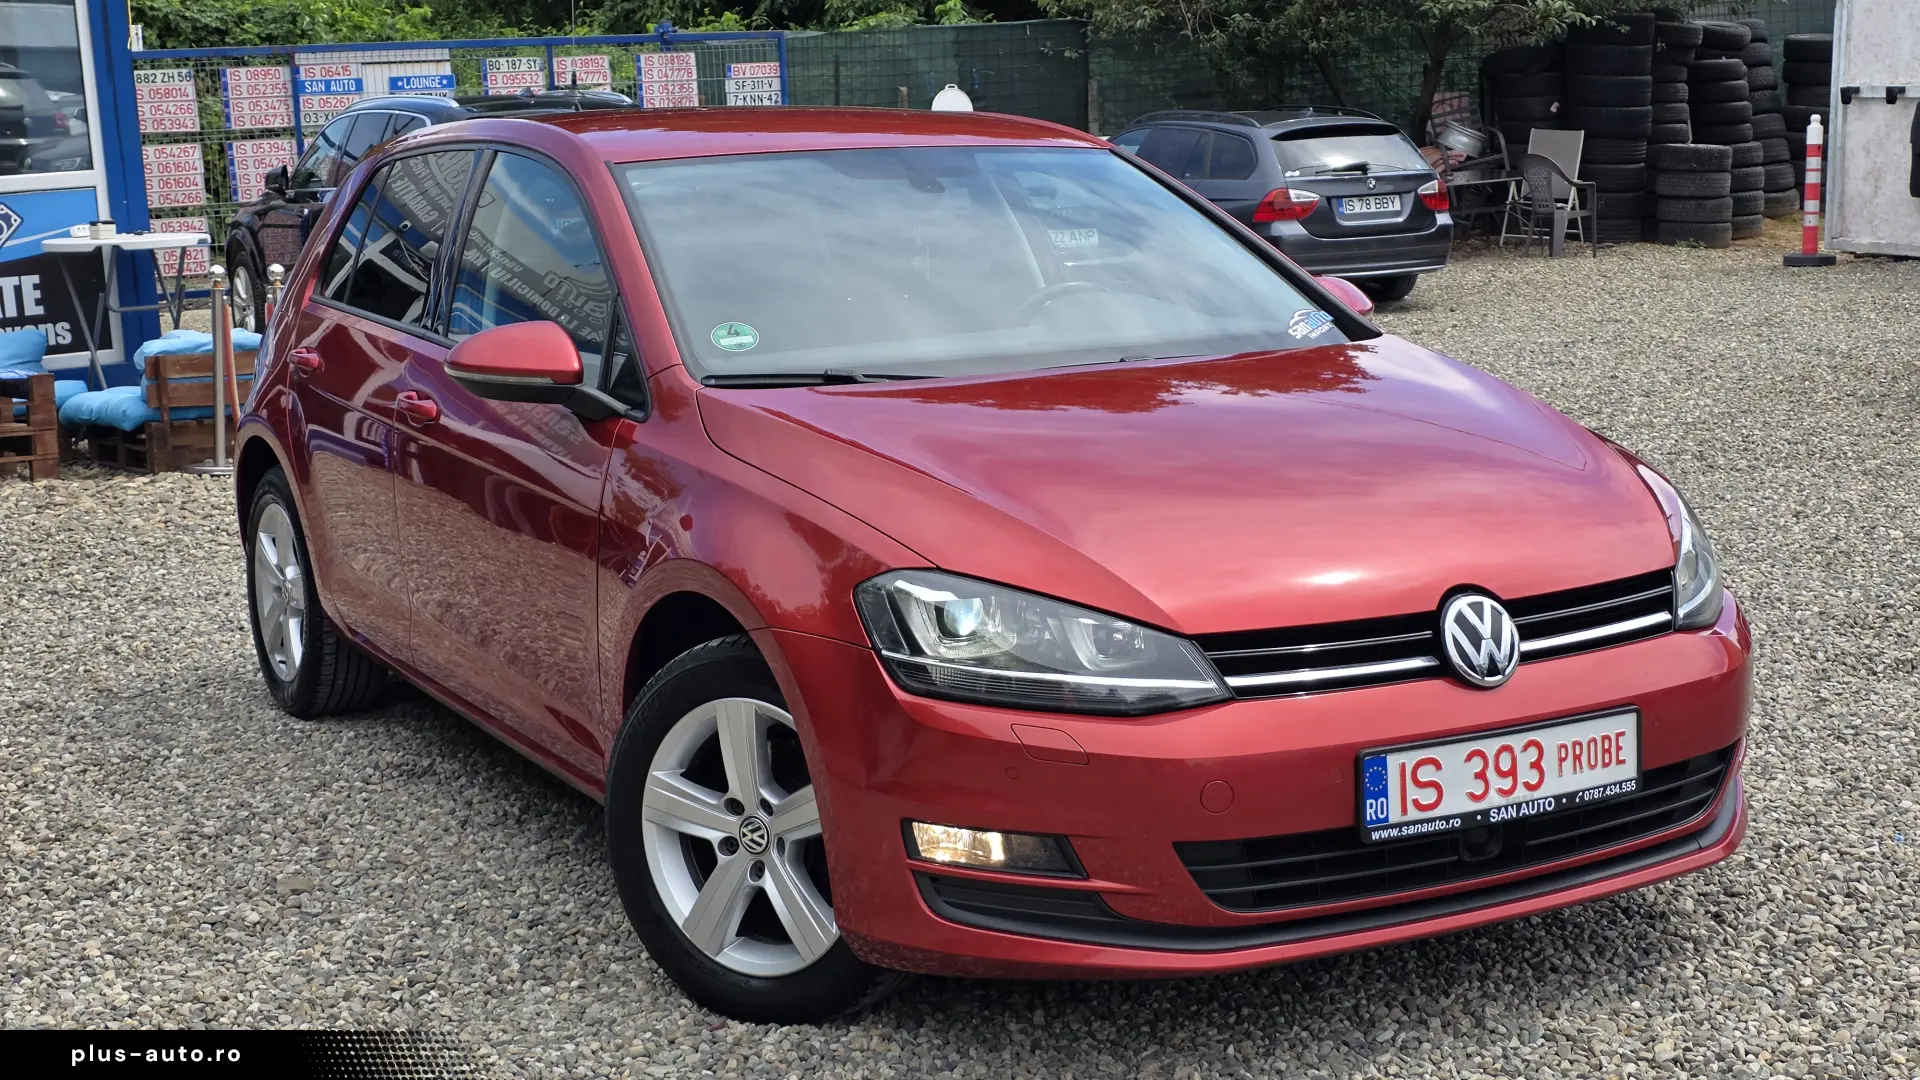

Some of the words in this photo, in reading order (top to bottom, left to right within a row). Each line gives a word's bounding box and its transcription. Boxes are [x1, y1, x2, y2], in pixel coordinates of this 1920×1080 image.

[556, 59, 567, 70] IS
[645, 56, 654, 66] IS
[229, 70, 241, 81] IS
[246, 69, 280, 81] 08950
[304, 67, 316, 78] IS
[320, 65, 352, 78] 06415
[556, 72, 567, 83] IS
[571, 71, 608, 82] 47778
[644, 69, 654, 79] IS
[732, 66, 747, 76] BV
[749, 65, 780, 76] 07039
[136, 73, 158, 84] 882
[160, 72, 175, 83] ZH
[404, 76, 442, 89] LOUNGE
[489, 75, 498, 85] B
[502, 73, 540, 85] 095532
[231, 84, 243, 96] IS
[247, 83, 289, 95] 052355
[305, 81, 325, 93] SAN
[330, 80, 356, 92] AUTO
[645, 85, 654, 95] IS
[136, 88, 144, 100] S
[149, 87, 189, 99] 058014
[137, 105, 145, 117] S
[150, 103, 193, 116] 054266
[232, 101, 244, 112] IS
[248, 99, 290, 111] 053475
[302, 98, 314, 109] IS
[139, 119, 147, 131] S
[152, 118, 196, 131] 053943
[234, 116, 246, 127] IS
[250, 114, 292, 126] 045733
[142, 148, 149, 160] S
[154, 146, 197, 159] 054267
[235, 143, 247, 155] IS
[252, 141, 293, 154] 053943
[144, 163, 153, 174] S
[157, 161, 198, 174] 061604
[237, 159, 249, 170] IS
[146, 179, 154, 190] S
[158, 176, 198, 190] 061604
[239, 173, 251, 185] IS
[147, 195, 154, 206] S
[158, 192, 202, 205] 054266
[241, 189, 252, 200] IS
[1344, 199, 1355, 211] IS
[1359, 198, 1371, 210] 78
[1375, 197, 1397, 210] BBY
[161, 220, 204, 233] 053942
[163, 249, 204, 262] 05821
[163, 261, 206, 274] 05426
[0, 274, 44, 317] TE
[727, 324, 740, 336] 4
[1399, 755, 1444, 817] IS
[1463, 737, 1546, 803] 393
[1557, 730, 1627, 778] PROBE
[1584, 780, 1636, 801] 0787.434.555
[1366, 797, 1388, 822] RO
[1489, 803, 1518, 823] SAN
[1519, 797, 1555, 817] AUTO
[1370, 817, 1462, 841] www.sanauto.ro
